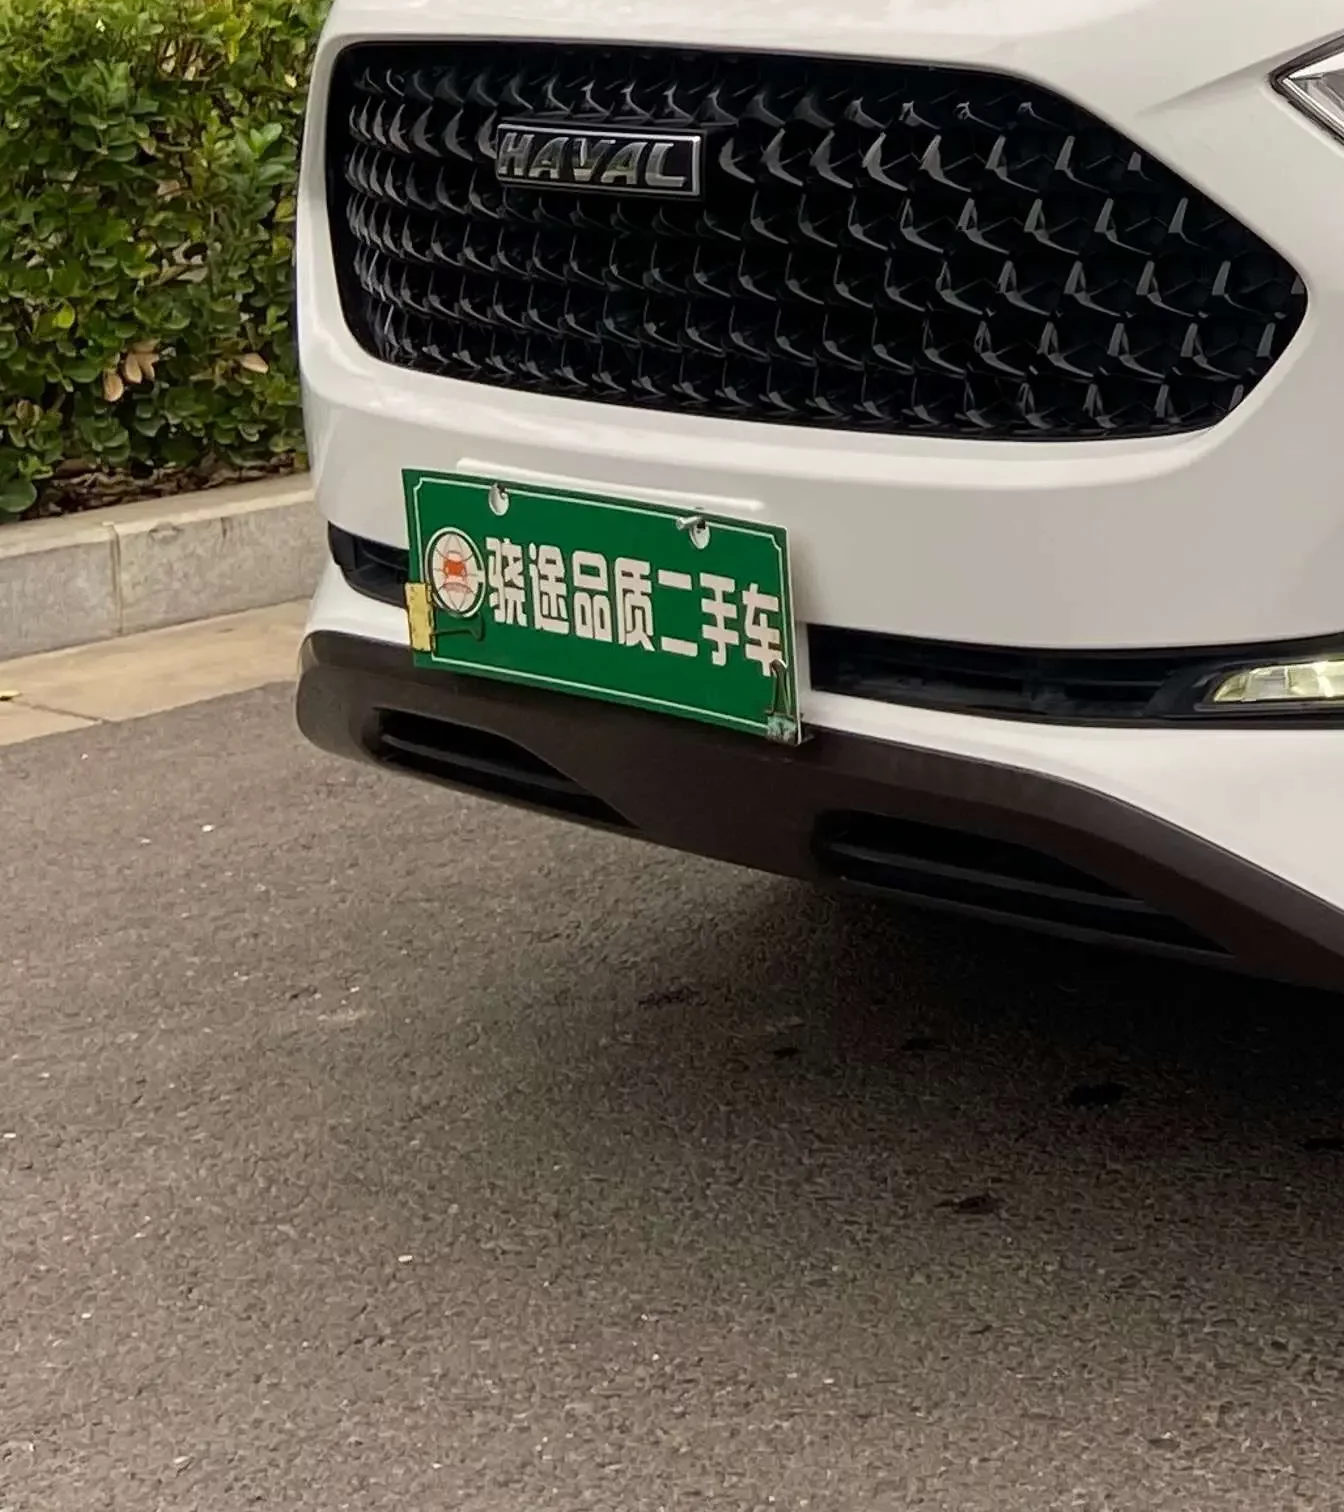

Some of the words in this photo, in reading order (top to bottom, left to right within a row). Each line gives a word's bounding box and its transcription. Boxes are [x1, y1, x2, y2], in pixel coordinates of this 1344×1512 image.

[498, 131, 687, 188] HAVAL
[485, 537, 782, 677] 骁途品质二手车
